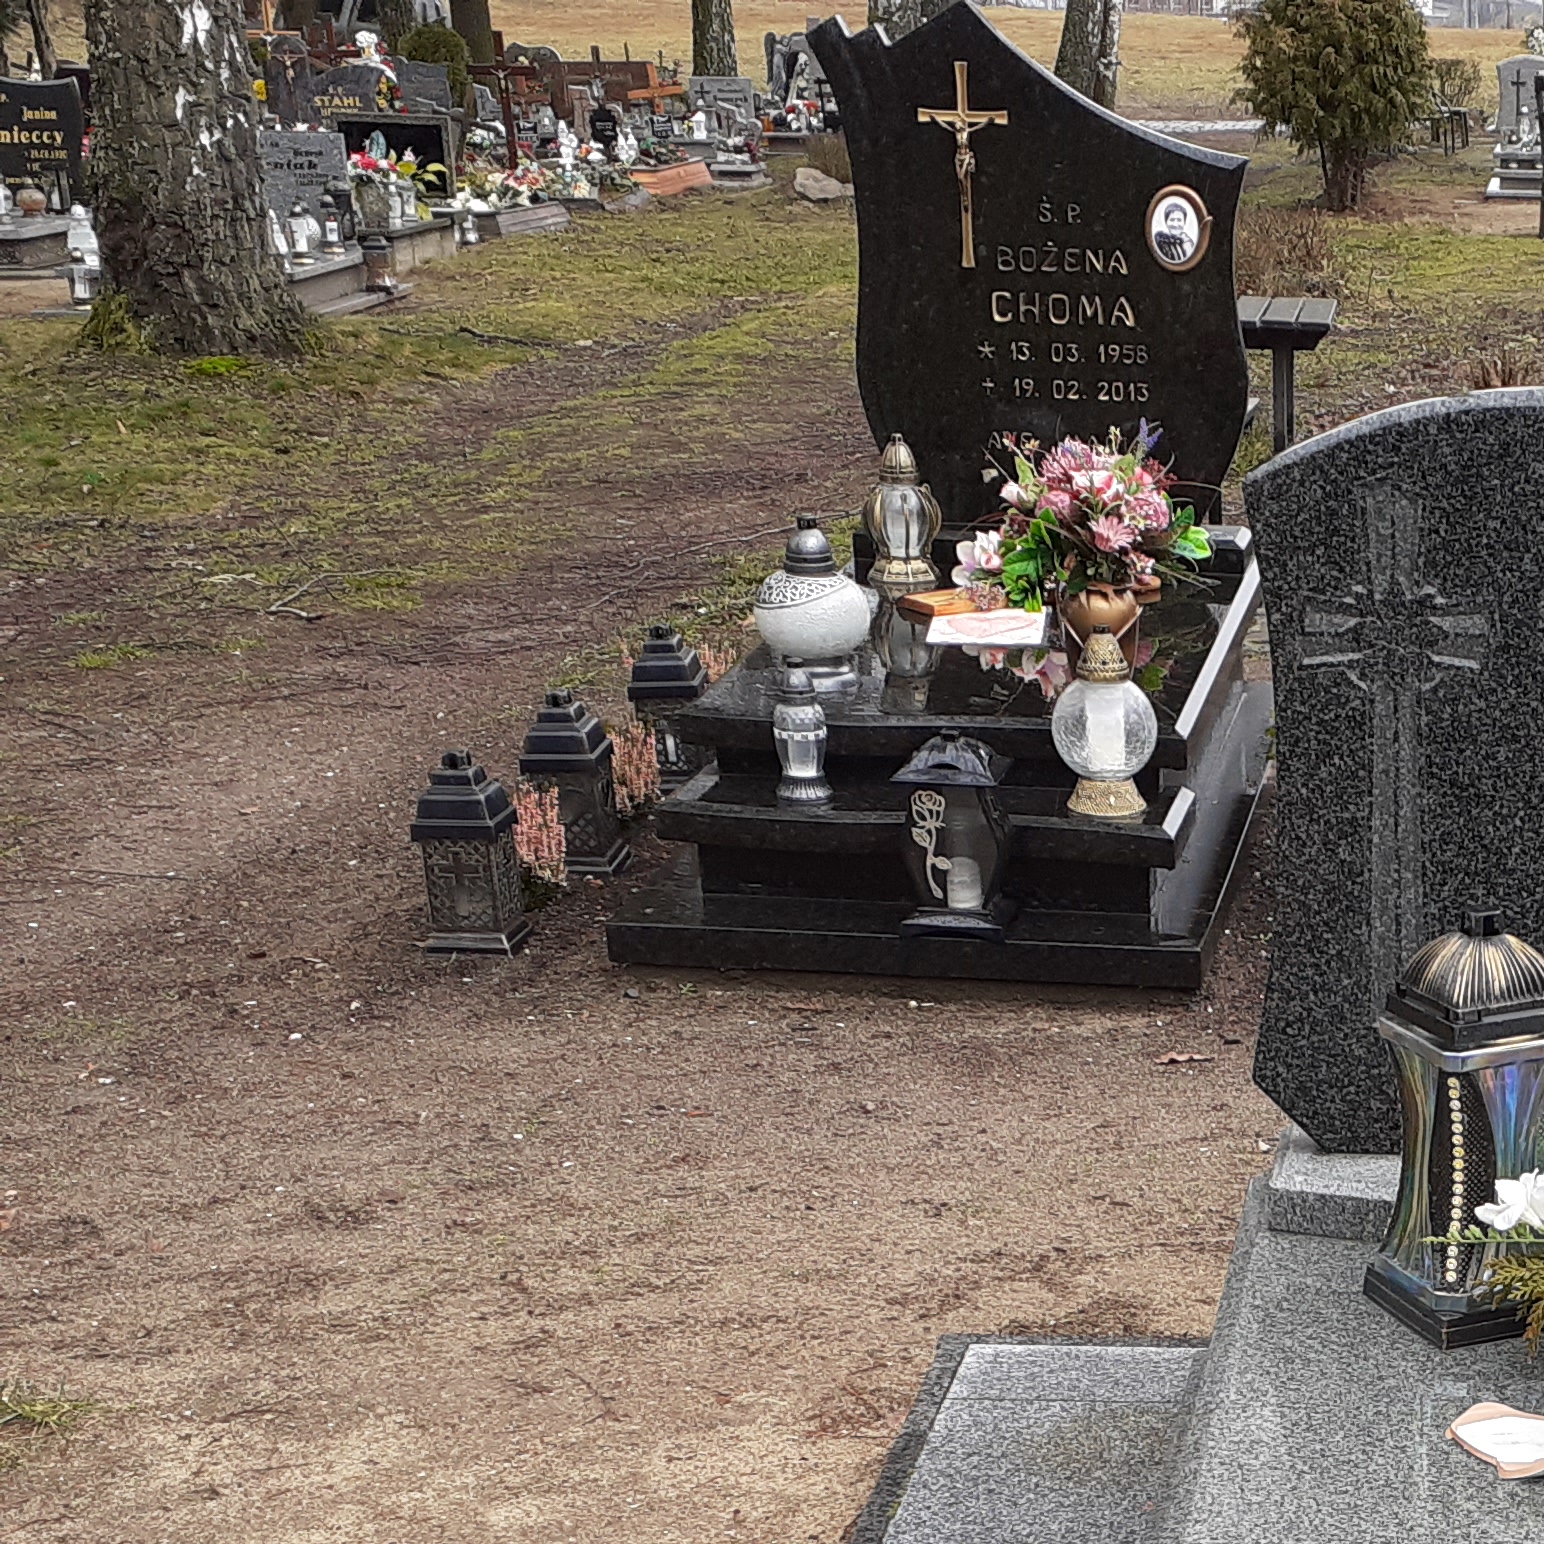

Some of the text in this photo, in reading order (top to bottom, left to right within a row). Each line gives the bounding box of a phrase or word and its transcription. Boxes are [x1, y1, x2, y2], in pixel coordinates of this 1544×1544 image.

[314, 96, 363, 107] STAHL
[22, 106, 58, 121] Janina
[1067, 204, 1082, 224] P.
[997, 241, 1129, 275] BOŻENA
[991, 291, 1136, 327] CHOMA
[1013, 378, 1149, 402] 19. 02. 2013
